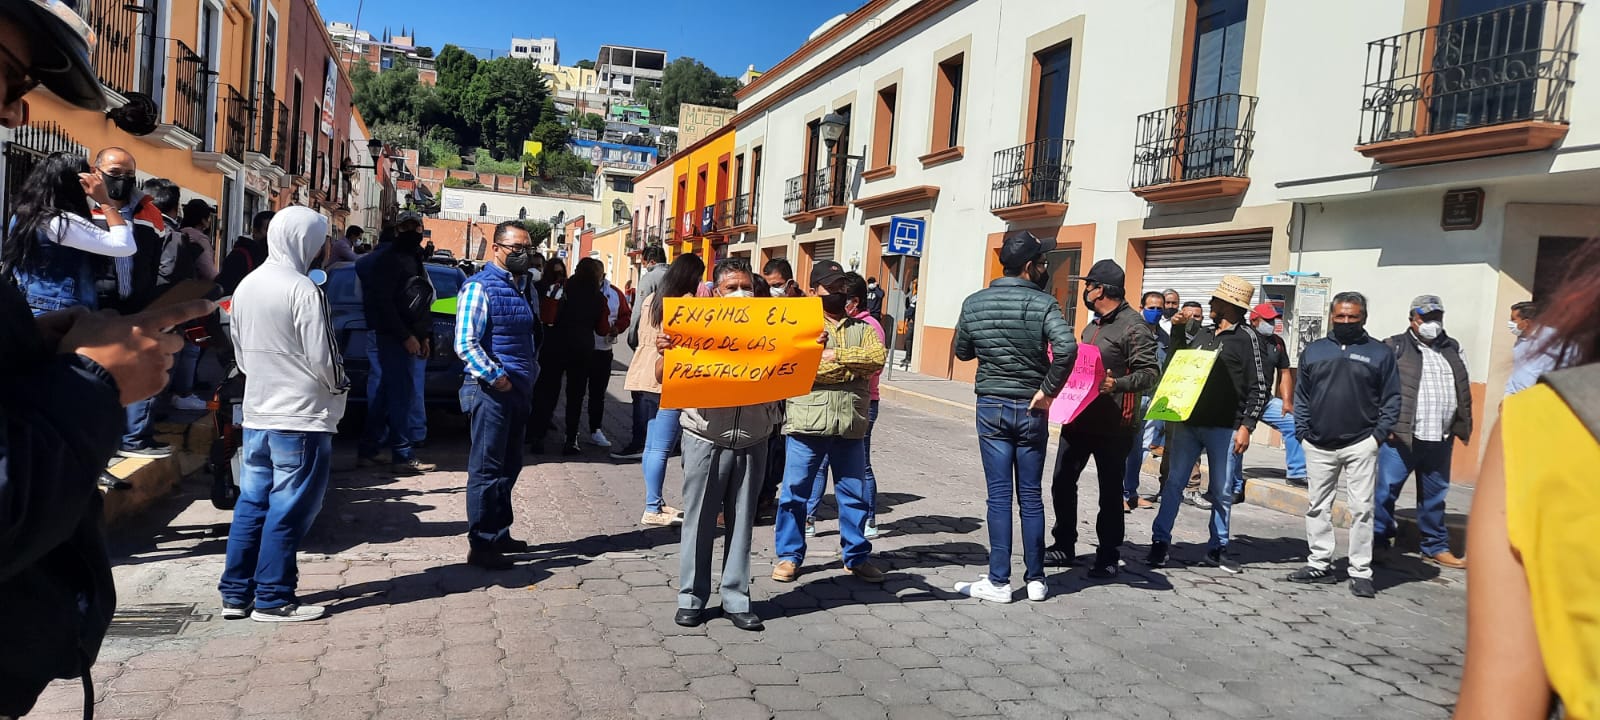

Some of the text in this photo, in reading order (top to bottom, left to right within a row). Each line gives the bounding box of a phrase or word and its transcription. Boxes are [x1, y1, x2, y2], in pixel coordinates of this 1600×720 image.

[668, 304, 798, 327] EXIGIMOS EL
[671, 334, 777, 355] PAGO DE LAS
[669, 362, 798, 380] PRESTACIONES
